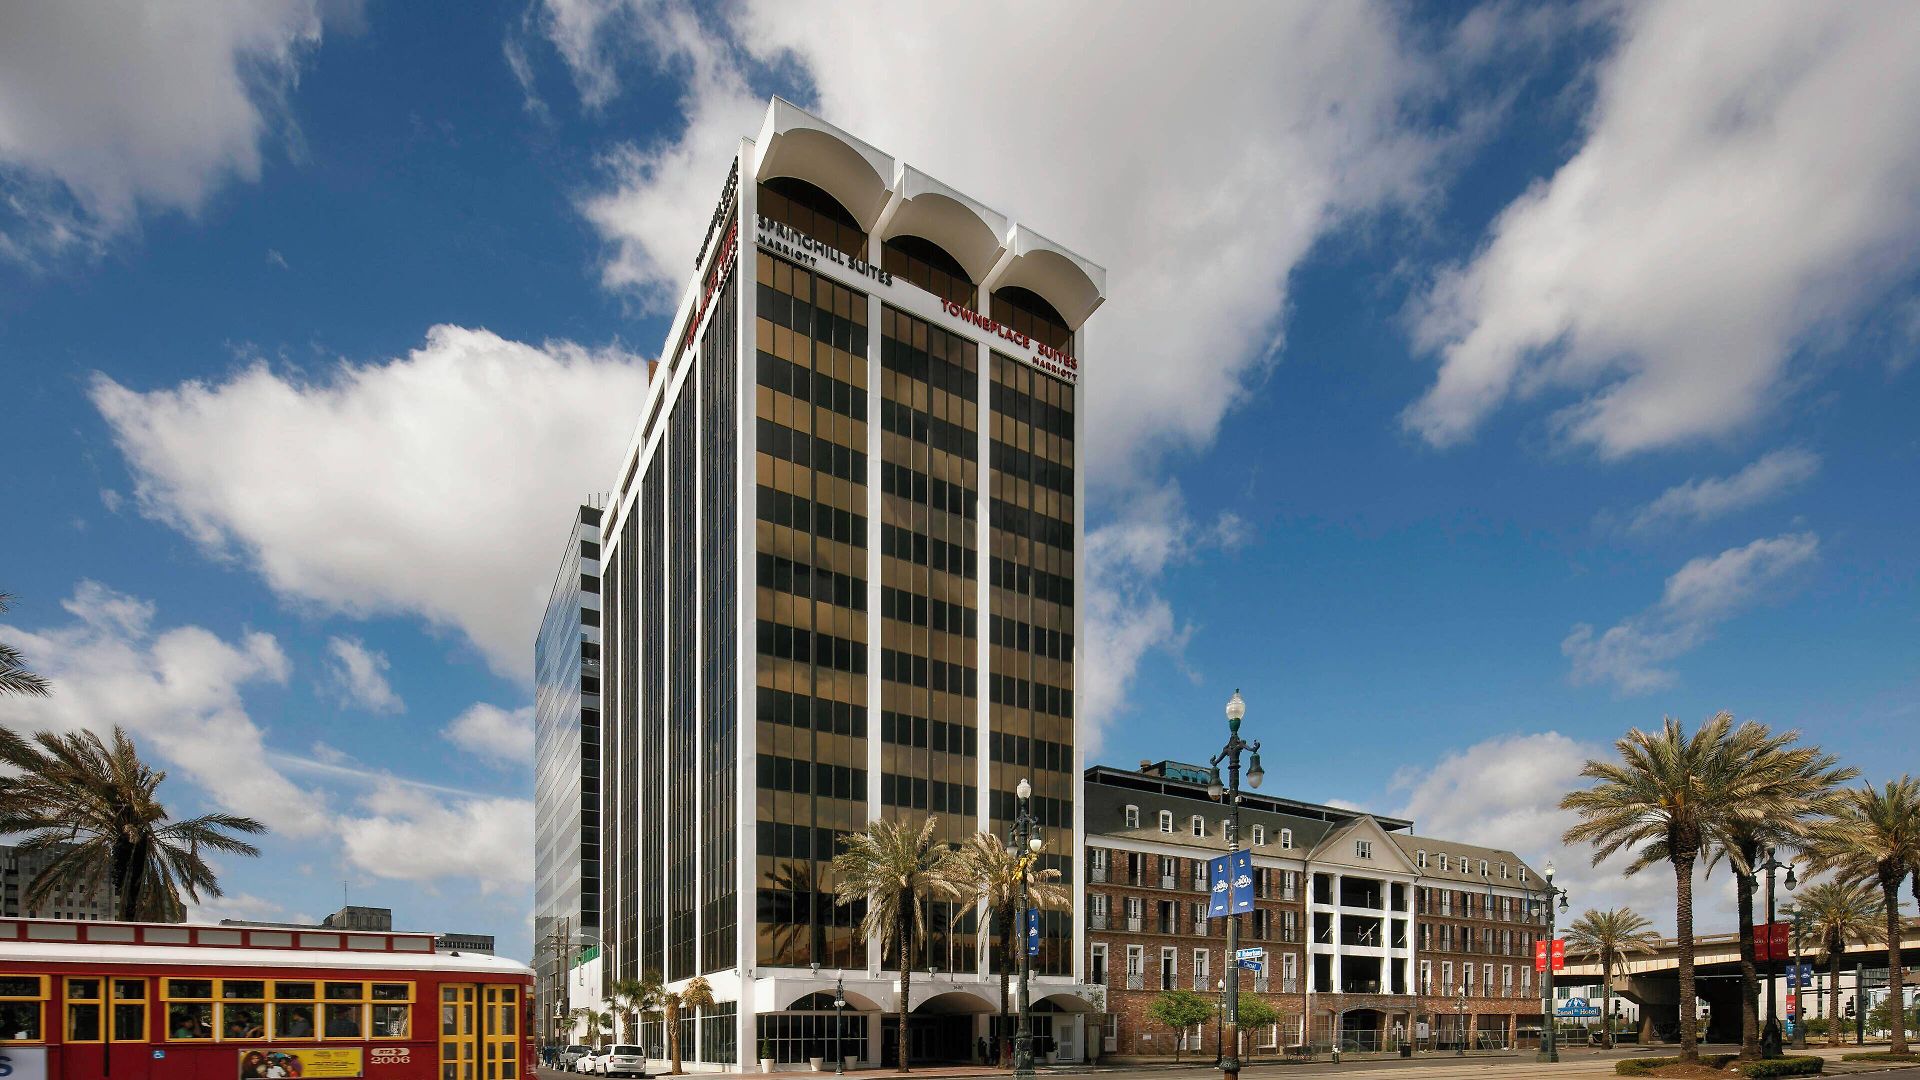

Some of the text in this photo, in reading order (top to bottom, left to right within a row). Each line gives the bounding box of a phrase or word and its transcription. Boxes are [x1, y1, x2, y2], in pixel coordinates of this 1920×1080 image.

[757, 233, 818, 267] MARRIOTT
[757, 215, 845, 266] SPRINGHILL
[847, 255, 893, 287] SUITES
[940, 298, 1078, 371] TOWNEPLACE SUITES
[1032, 355, 1078, 382] MARRIOTT
[370, 1056, 411, 1064] 2006
